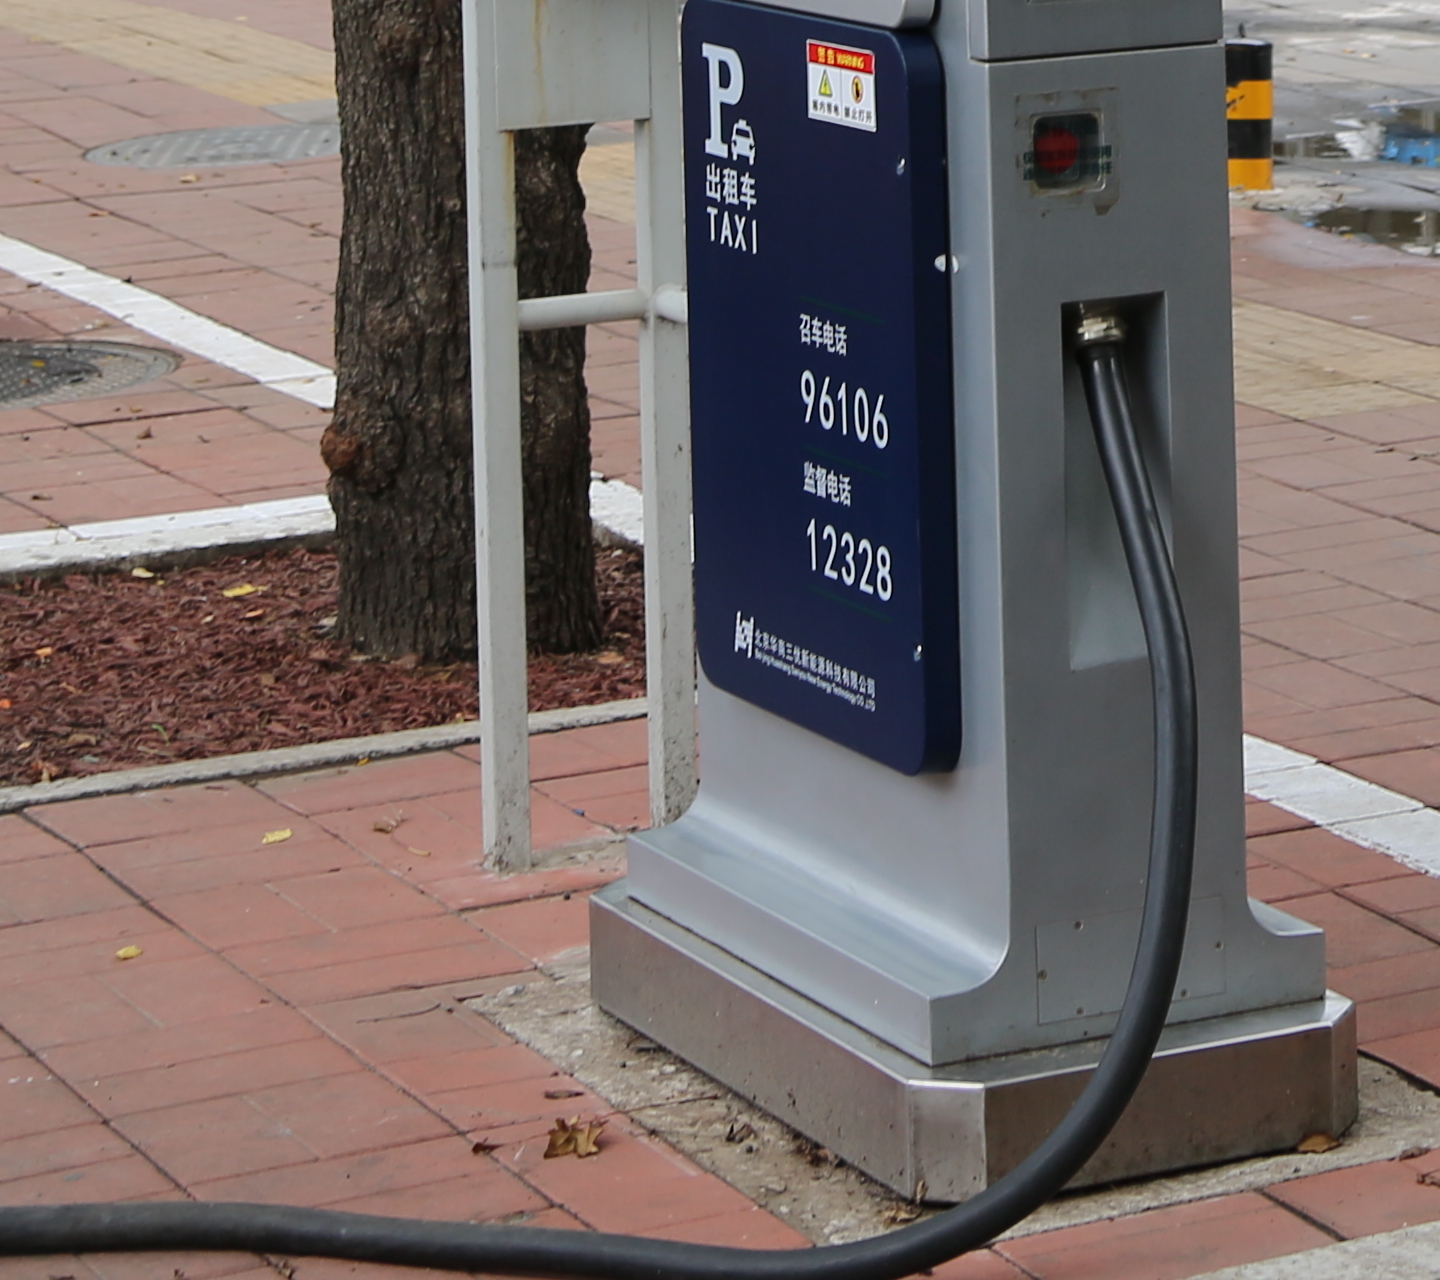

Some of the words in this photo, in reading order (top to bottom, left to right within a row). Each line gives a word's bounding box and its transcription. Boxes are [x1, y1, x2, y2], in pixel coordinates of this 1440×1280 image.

[701, 41, 745, 159] P
[705, 162, 758, 211] 出租车
[706, 205, 758, 255] TAXI
[799, 312, 848, 357] 召车电话
[800, 368, 890, 450] 96106
[803, 460, 852, 508] 监督电话
[806, 517, 893, 602] 12328
